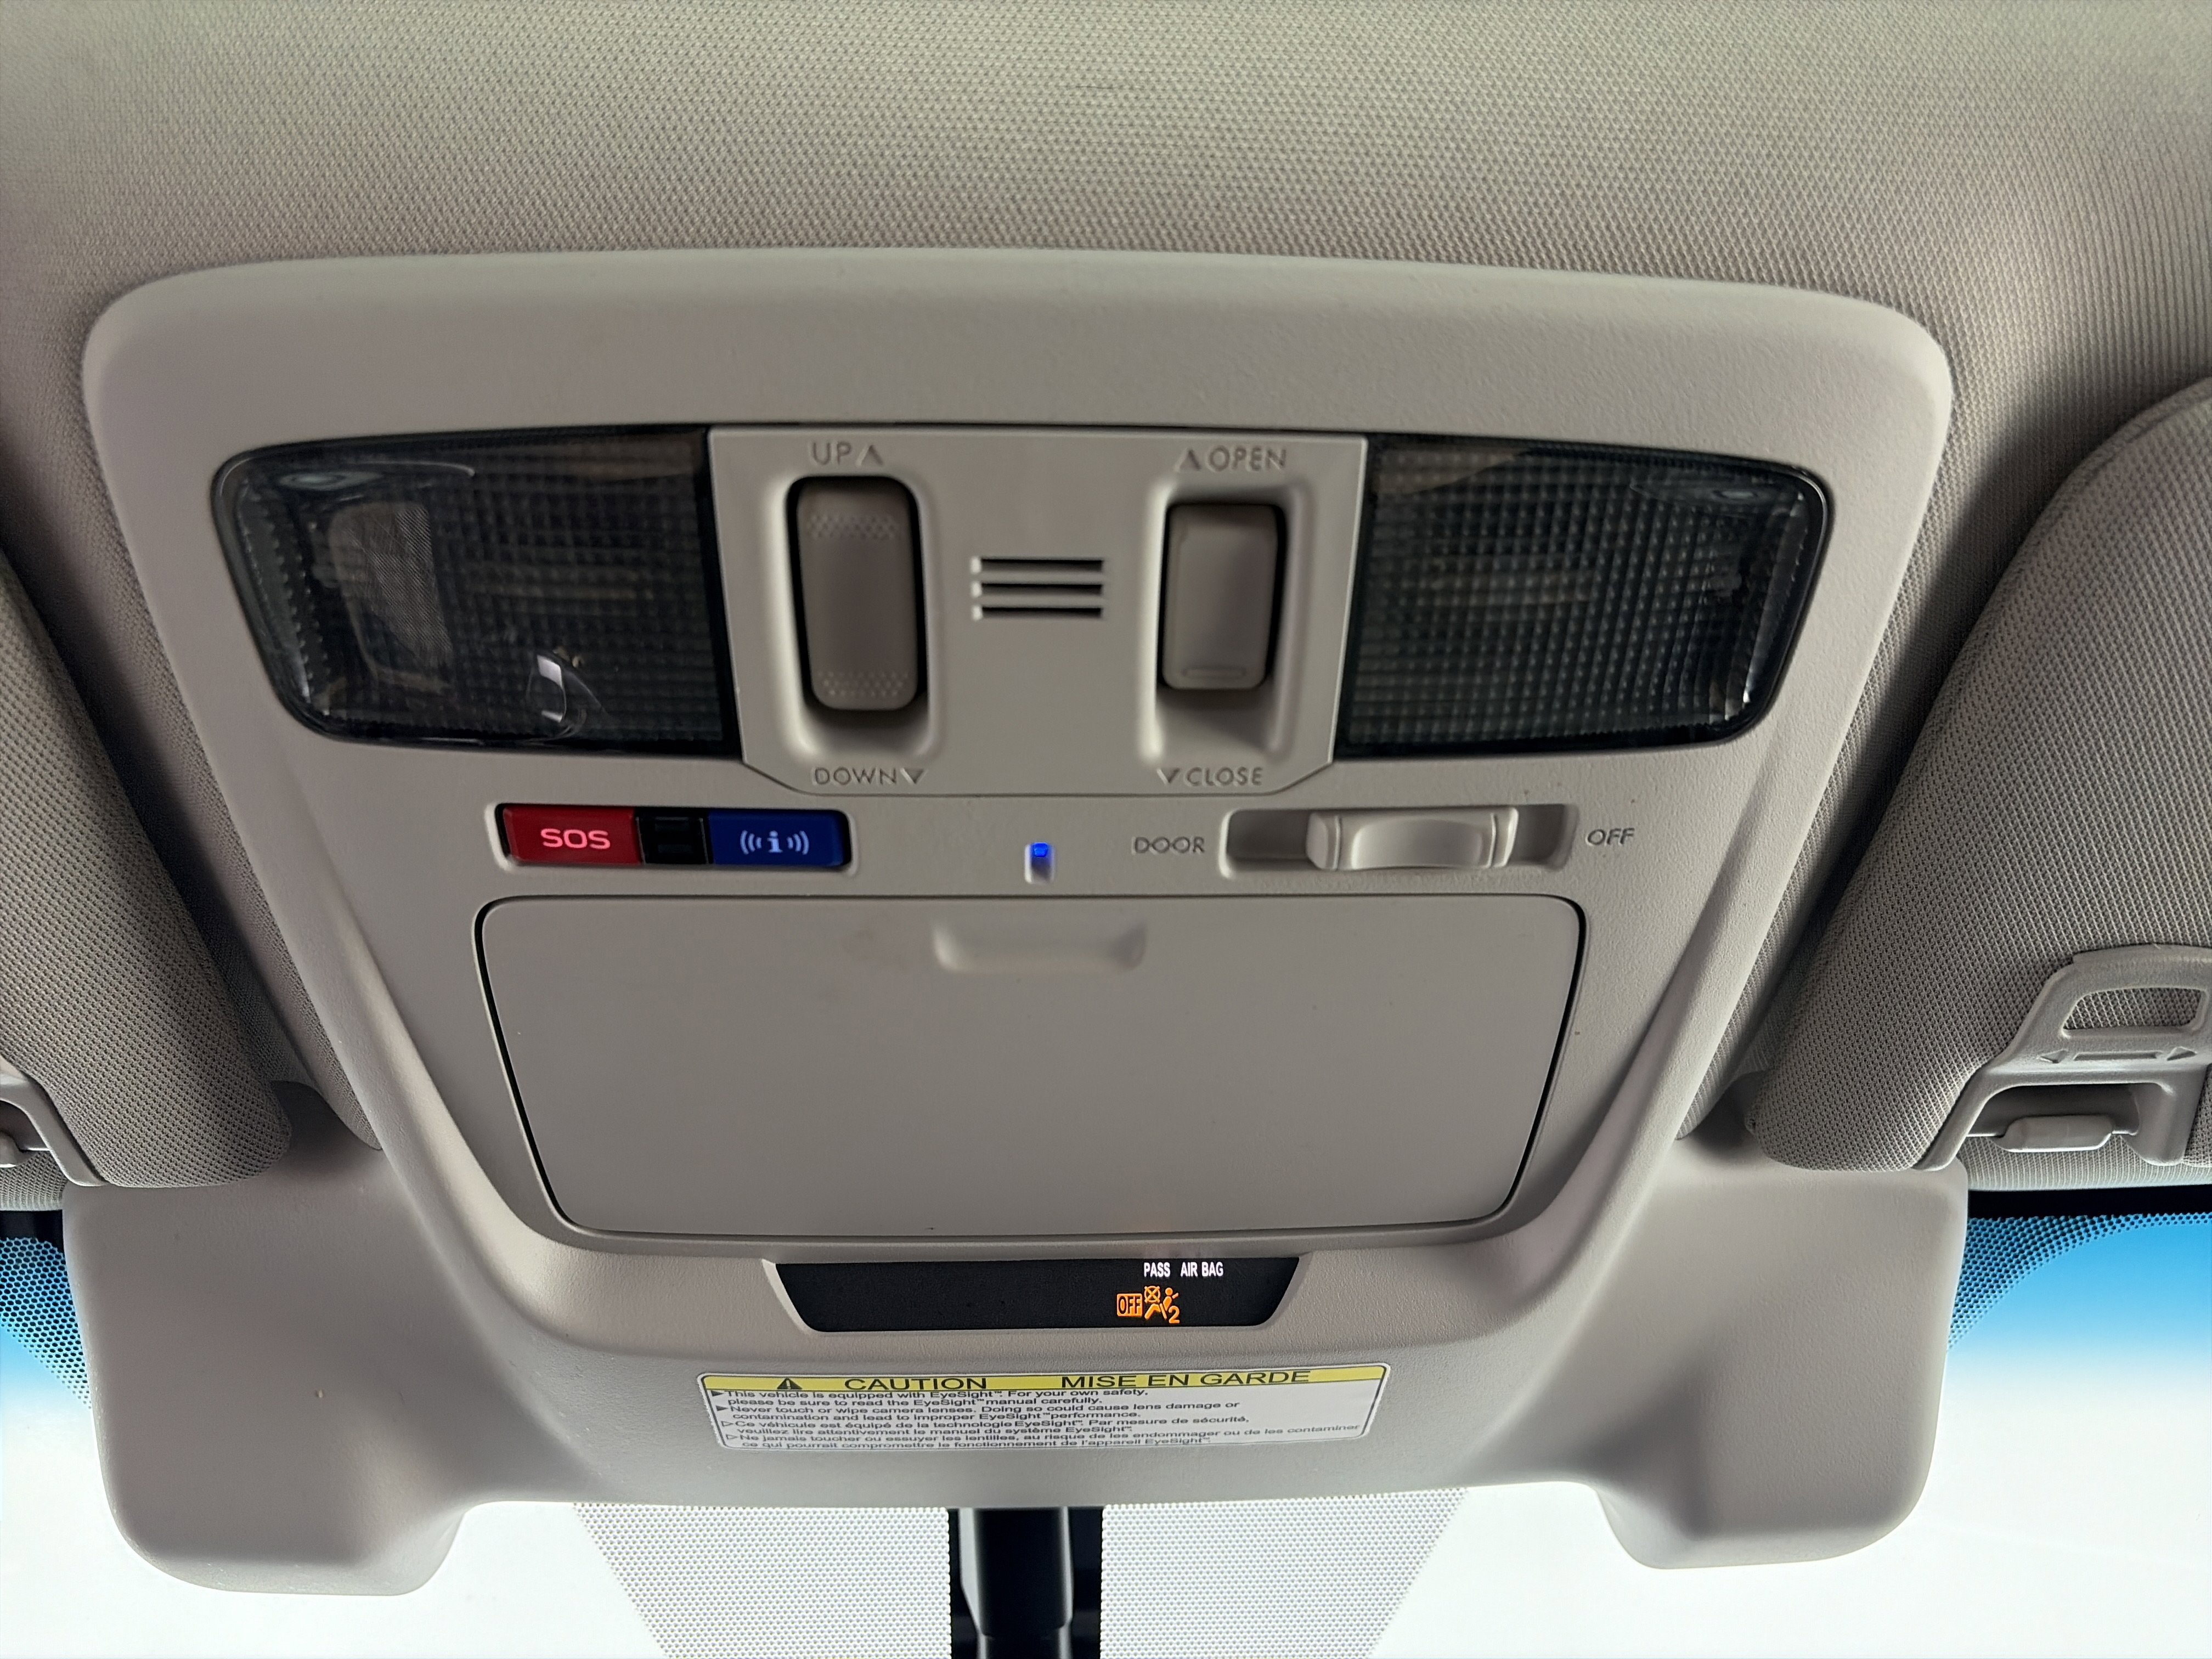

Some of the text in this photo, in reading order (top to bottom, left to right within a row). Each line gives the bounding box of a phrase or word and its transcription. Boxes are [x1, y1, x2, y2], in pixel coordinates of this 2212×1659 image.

[812, 441, 853, 465] UP
[1208, 444, 1287, 472] OPEN
[814, 766, 897, 786] DOWN
[1185, 766, 1263, 786] CLOSE
[540, 828, 611, 850] SOS
[1133, 836, 1205, 854] DOOR
[1585, 827, 1635, 846] OFF
[1144, 1262, 1224, 1277] PASS AIR BAG
[1118, 1295, 1142, 1314] OFF
[844, 1378, 987, 1390] CAUTION
[1062, 1370, 1311, 1388] MISE EN GARDE
[1287, 1425, 1360, 1434] contaminer
